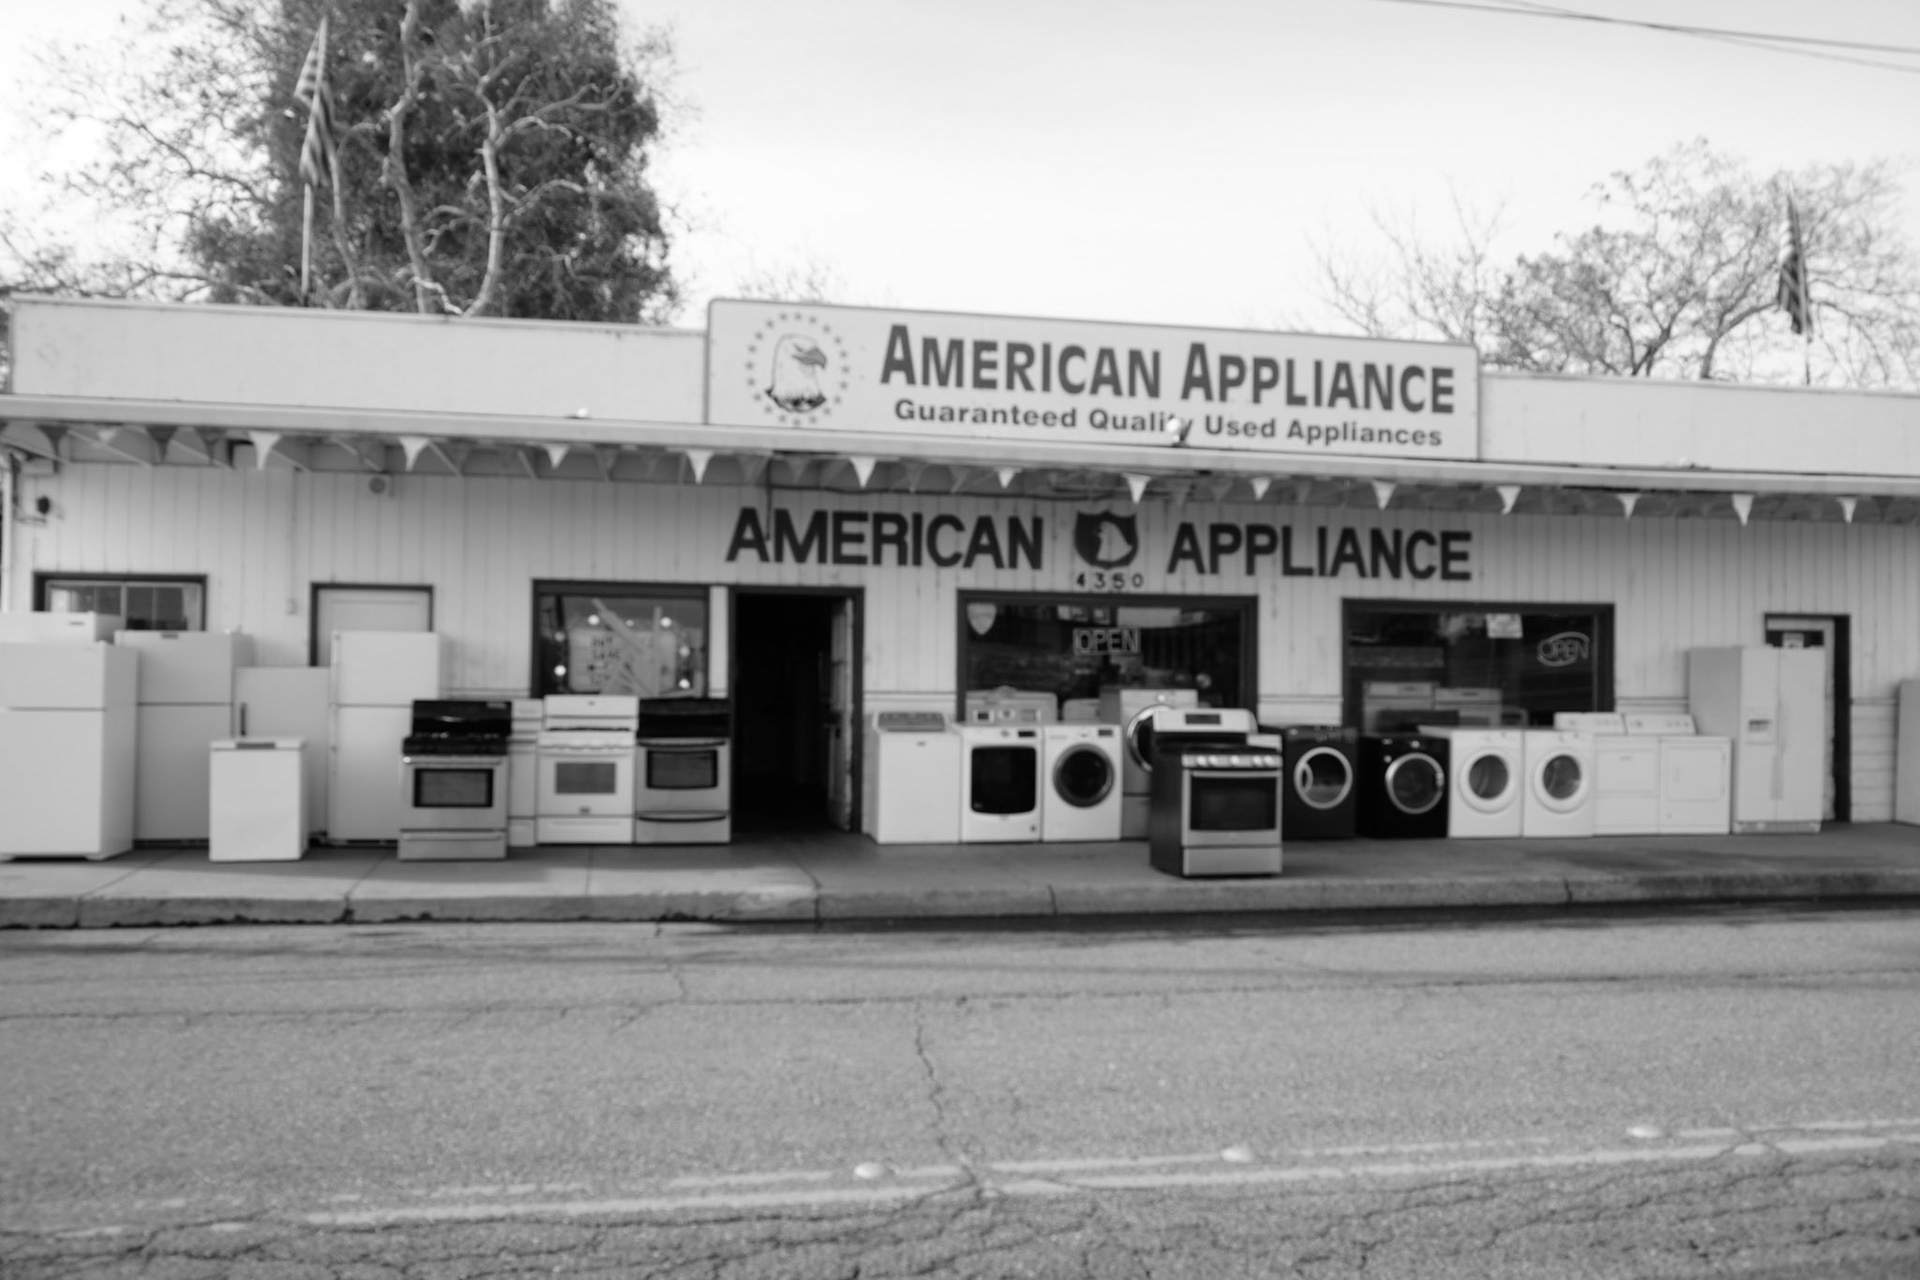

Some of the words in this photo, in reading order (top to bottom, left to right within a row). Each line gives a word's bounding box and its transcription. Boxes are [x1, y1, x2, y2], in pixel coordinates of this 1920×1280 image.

[880, 324, 1160, 398] AMERICAN
[1181, 343, 1454, 413] APPLIANCE
[895, 399, 1076, 428] Guaranteed
[1089, 409, 1192, 440] Qualiy
[1205, 415, 1276, 438] Used
[1287, 419, 1442, 446] Appliances
[725, 507, 1043, 570] AMERICAN
[1167, 522, 1472, 581] APPLIANCE
[1077, 572, 1144, 589] 4350
[1079, 629, 1139, 653] OPEN
[1538, 638, 1589, 660] OPEN
